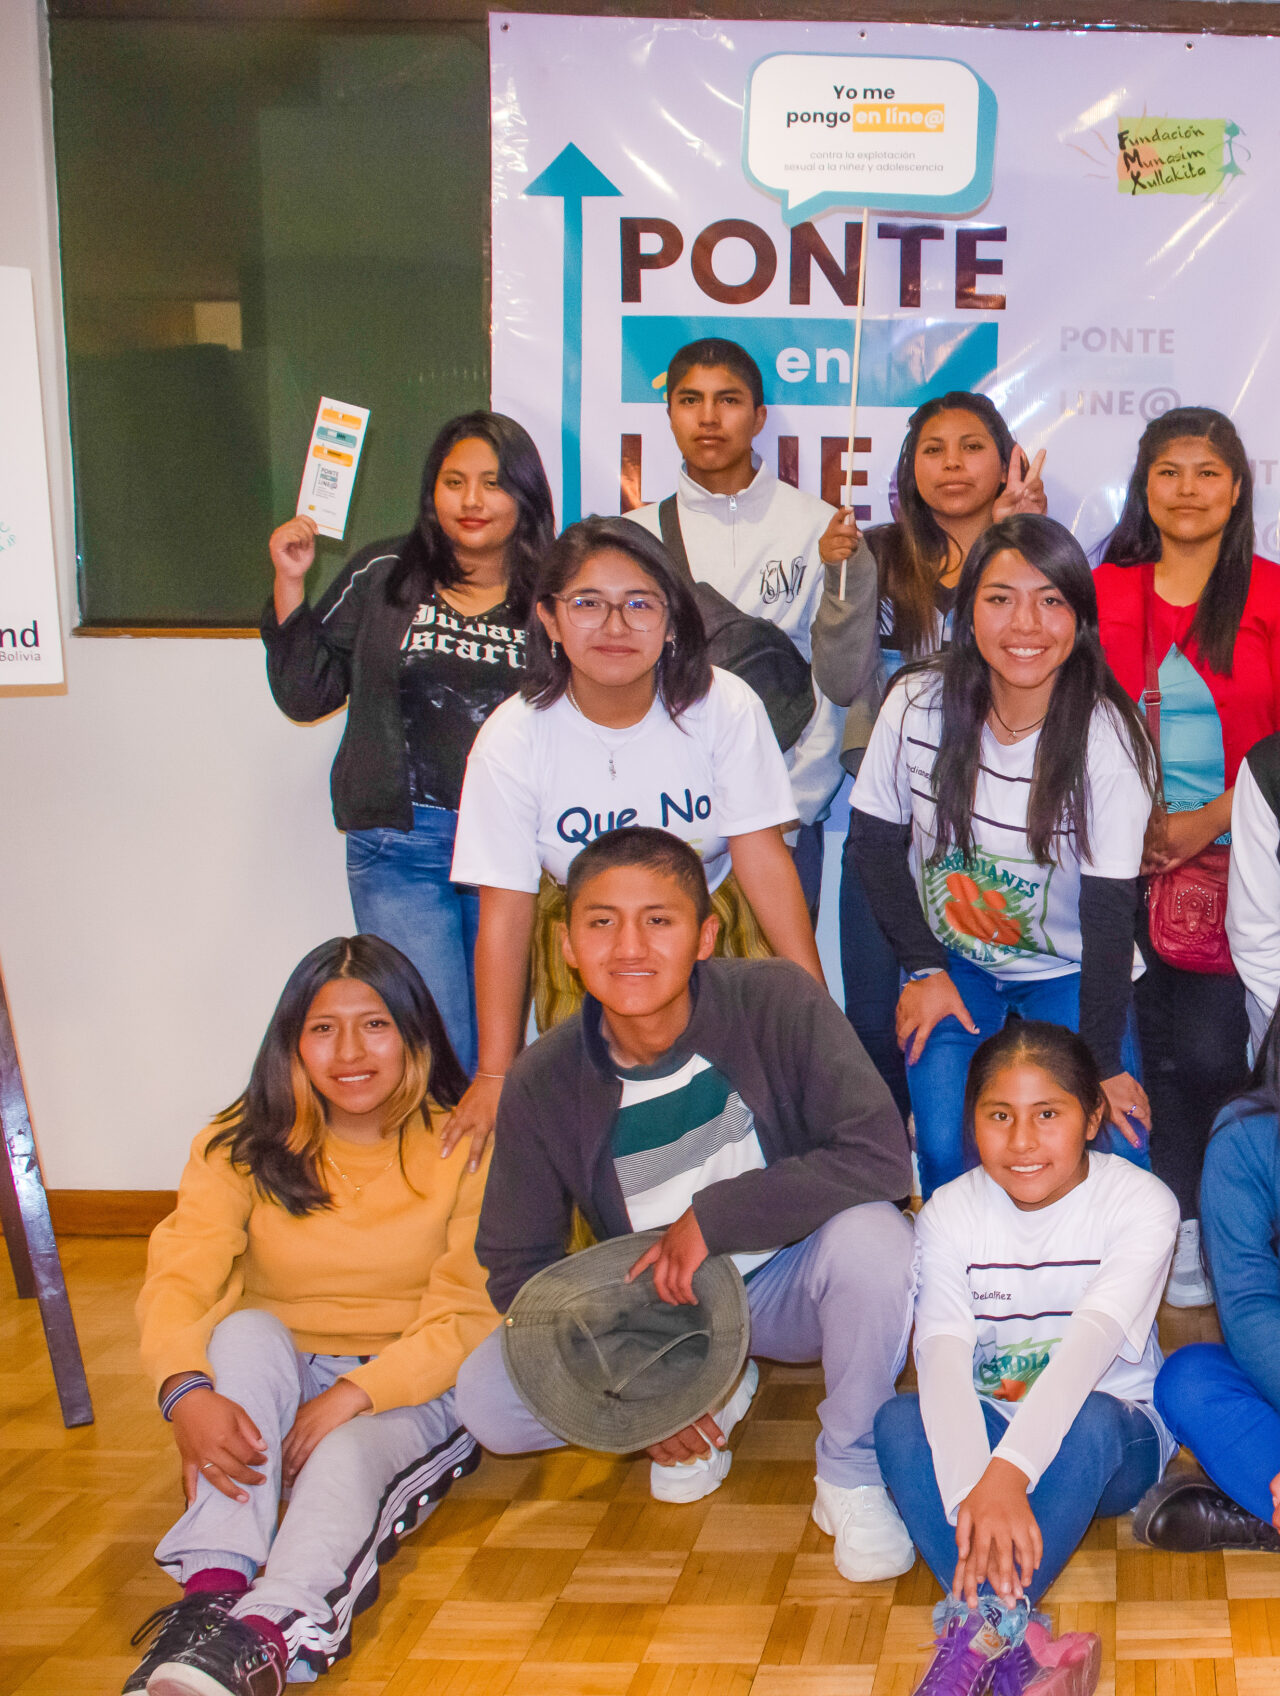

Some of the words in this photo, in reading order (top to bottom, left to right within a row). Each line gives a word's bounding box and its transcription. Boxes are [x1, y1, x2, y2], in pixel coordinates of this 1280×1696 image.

[833, 85, 858, 100] Yo
[863, 87, 895, 100] me
[786, 111, 851, 128] pongo
[855, 110, 880, 125] en
[1117, 126, 1204, 150] Fundación
[784, 162, 816, 171] sexual
[828, 162, 837, 171] la
[839, 162, 865, 171] niñez
[876, 162, 944, 172] adolescencia
[810, 151, 843, 160] contra
[845, 151, 855, 160] la
[857, 151, 916, 162] explotación
[1123, 146, 1204, 172] Munasim
[1130, 163, 1206, 195] Xullakita
[620, 217, 1007, 310] PONTE
[1060, 326, 1175, 354] PONTE
[776, 345, 852, 384] en
[1060, 387, 1181, 421] LINE@
[0, 651, 41, 662] Bolivia
[557, 806, 638, 846] Que
[660, 788, 711, 828] No
